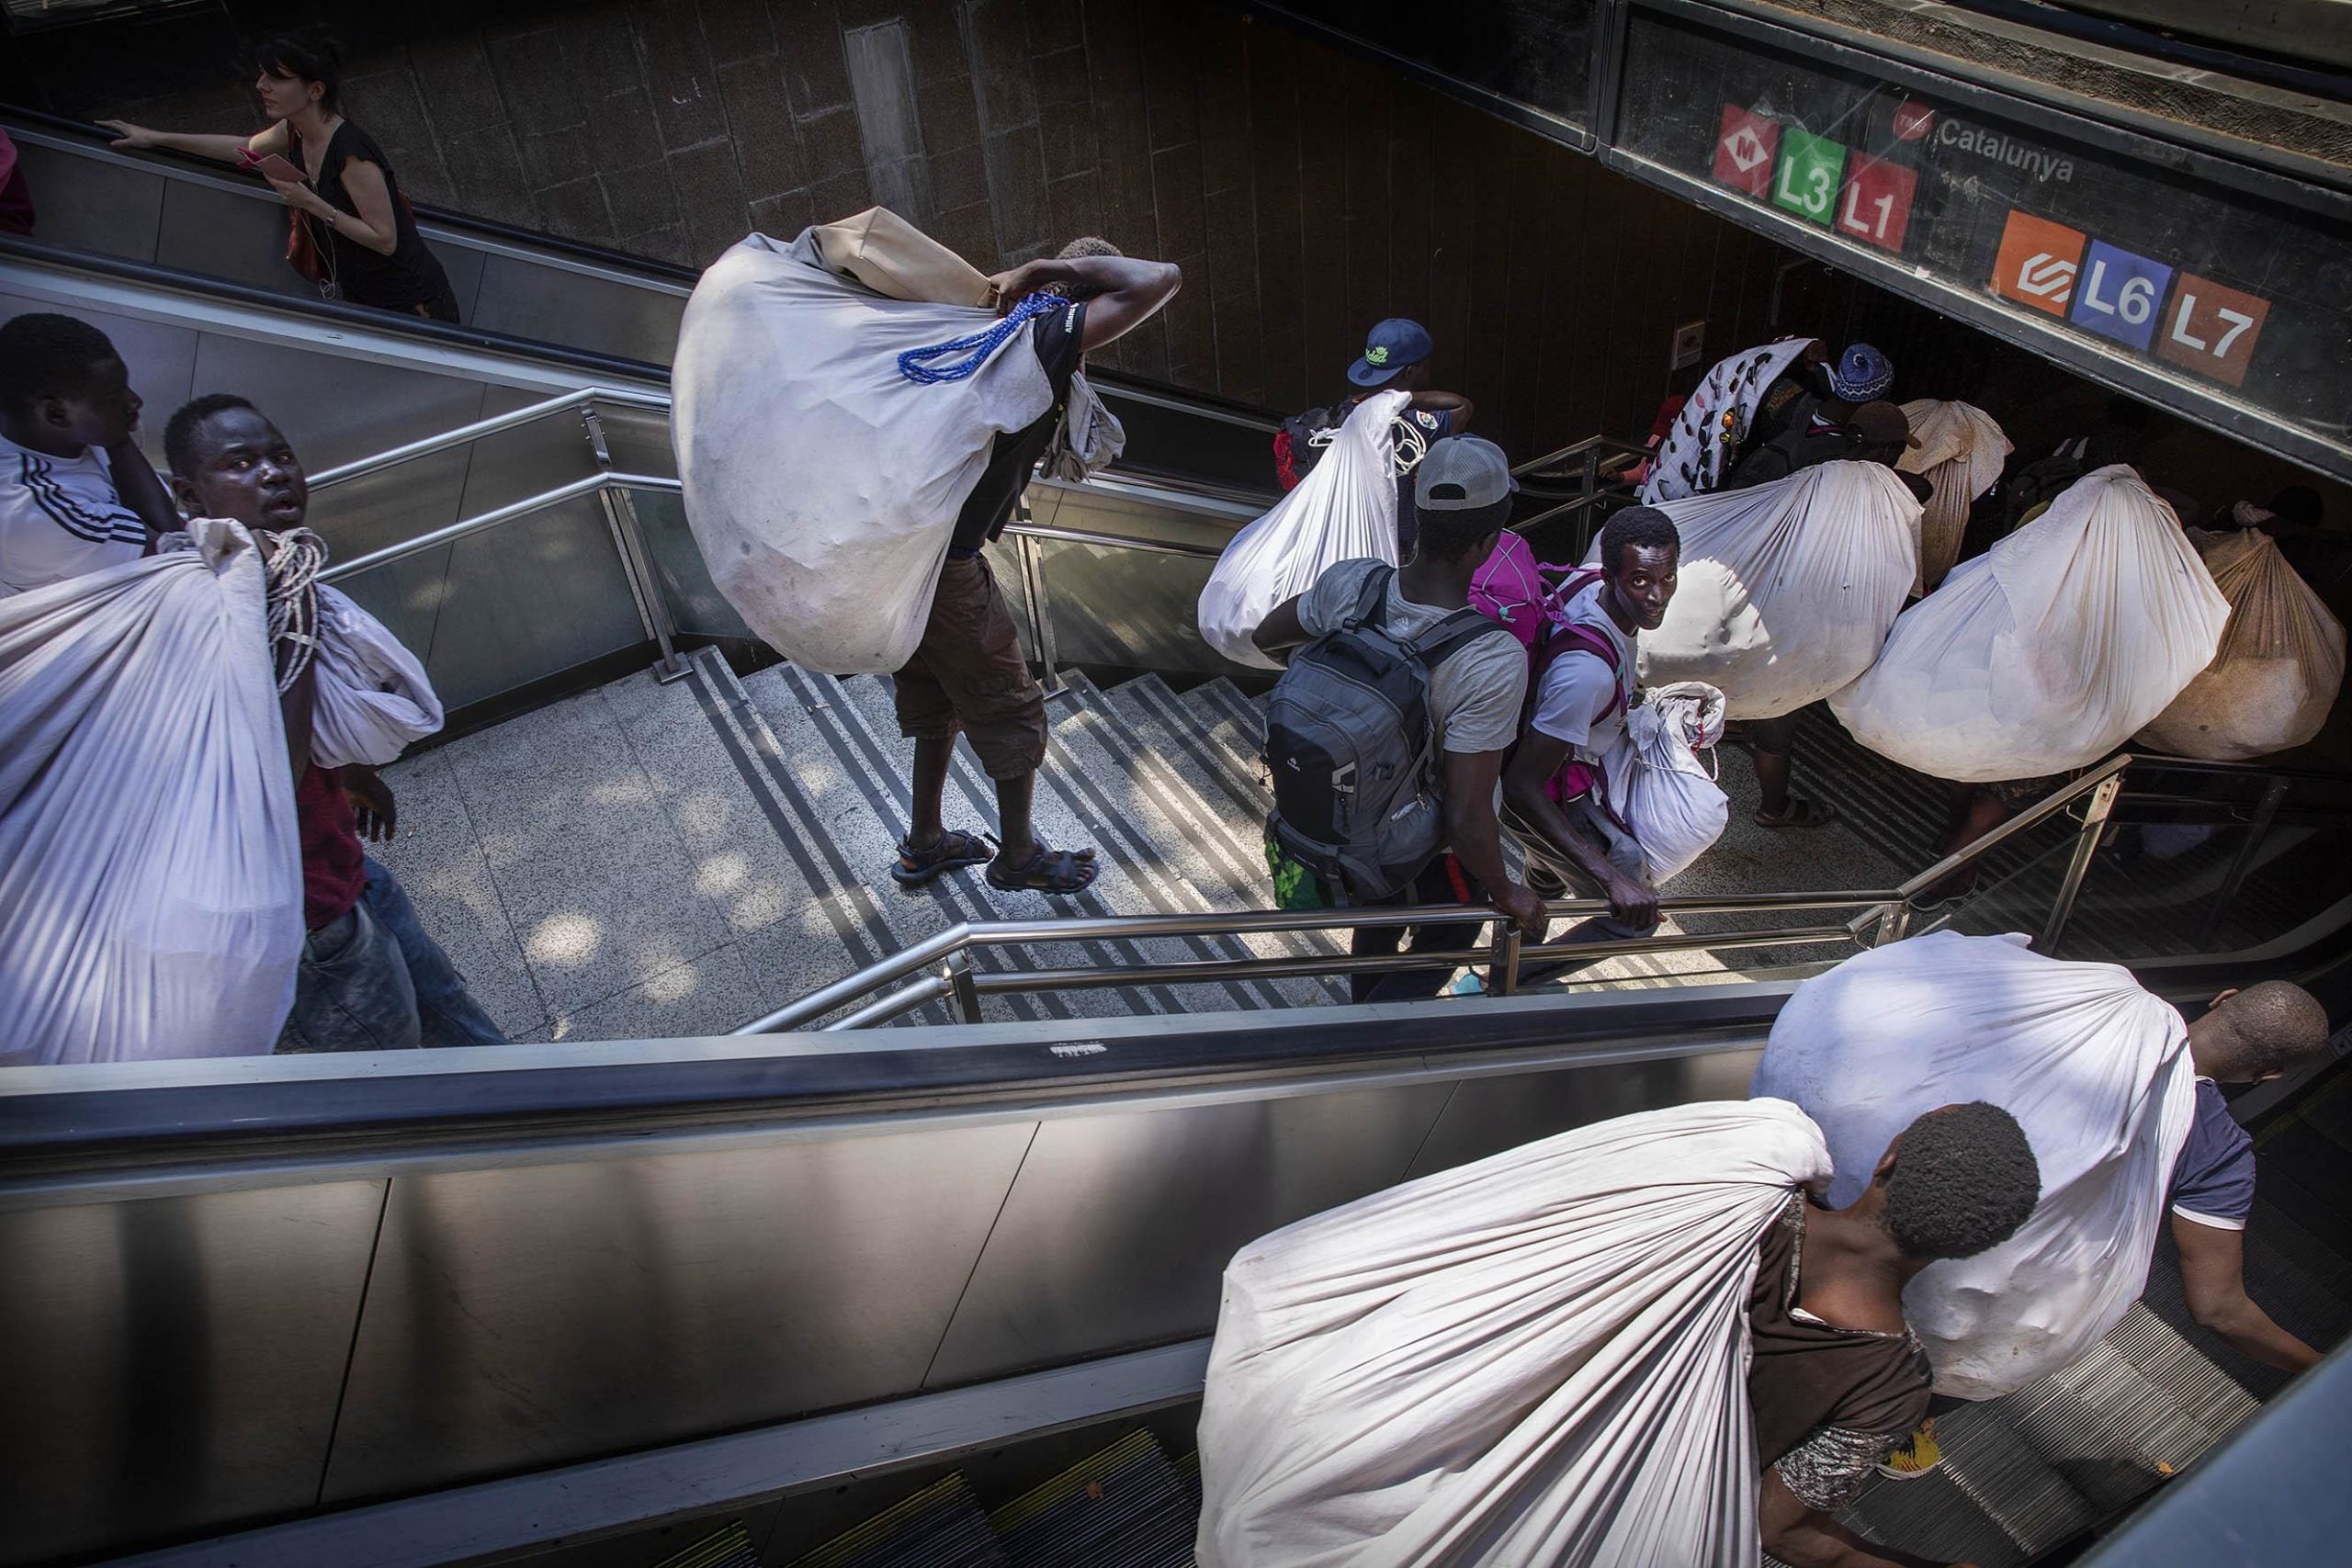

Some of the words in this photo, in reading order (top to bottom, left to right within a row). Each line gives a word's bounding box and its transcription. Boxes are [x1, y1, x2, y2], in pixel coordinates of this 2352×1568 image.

[1899, 115, 1928, 132] TMB
[1939, 118, 2074, 182] Catalunya
[1736, 135, 1758, 163] M
[1779, 155, 1831, 214] L3
[1844, 182, 1894, 239] L1
[2084, 259, 2154, 324] L6
[2171, 294, 2254, 358] L7
